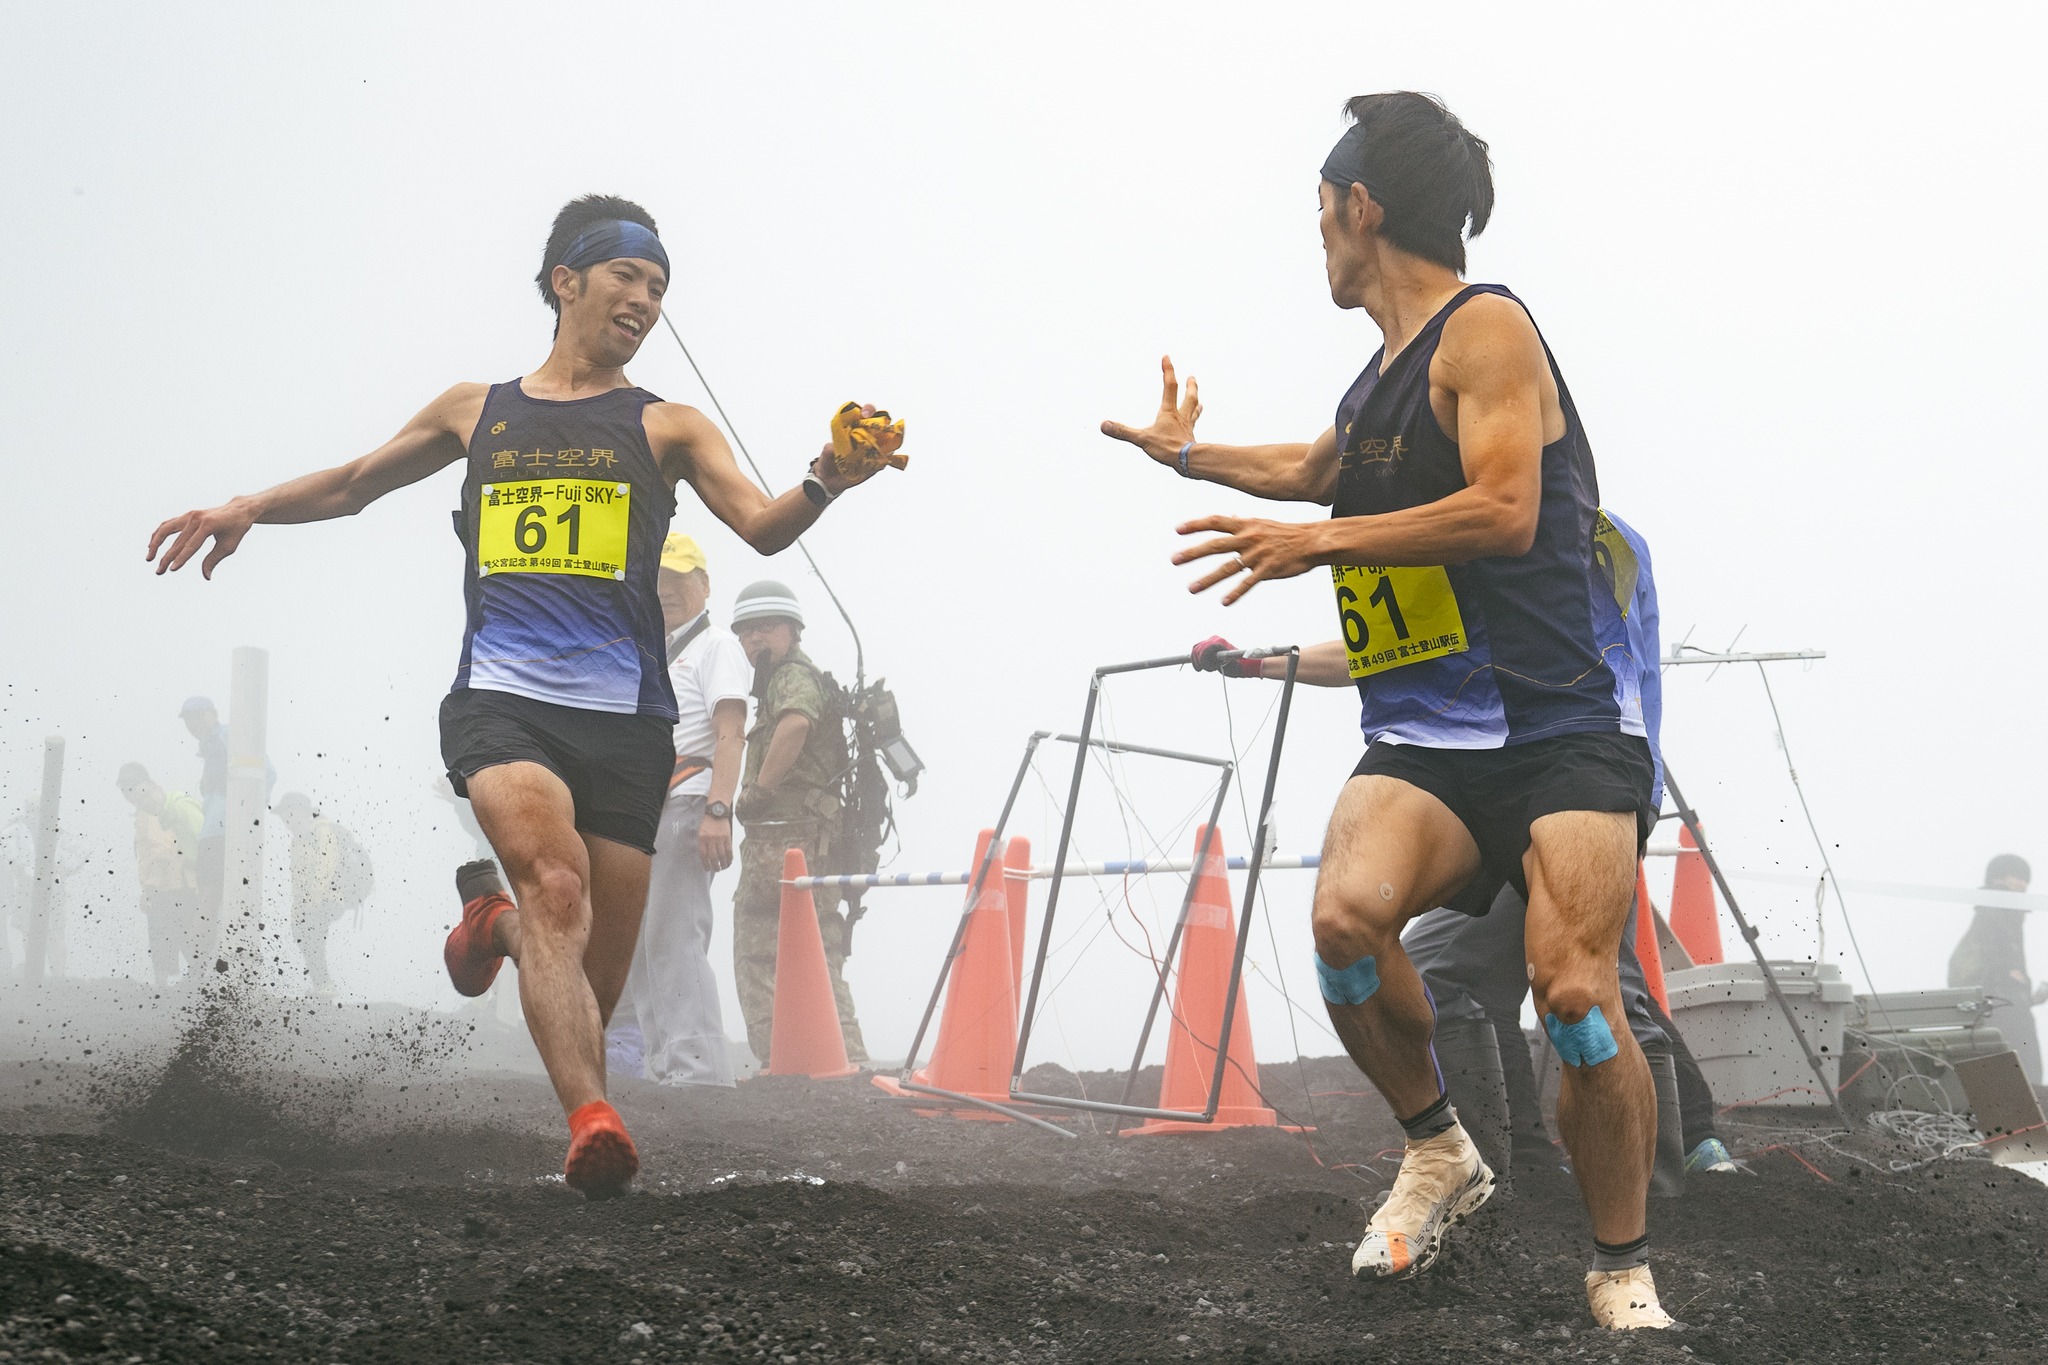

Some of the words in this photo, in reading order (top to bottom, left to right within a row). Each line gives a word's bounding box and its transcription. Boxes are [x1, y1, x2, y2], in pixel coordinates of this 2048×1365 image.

[491, 447, 619, 469] 富士空界
[514, 503, 581, 556] 61
[529, 557, 562, 568] 第49回
[564, 558, 619, 574] 富士登山駅伝
[1337, 575, 1410, 653] 61
[1360, 649, 1398, 669] 第49回
[1397, 633, 1460, 659] 富士登山駅伝
